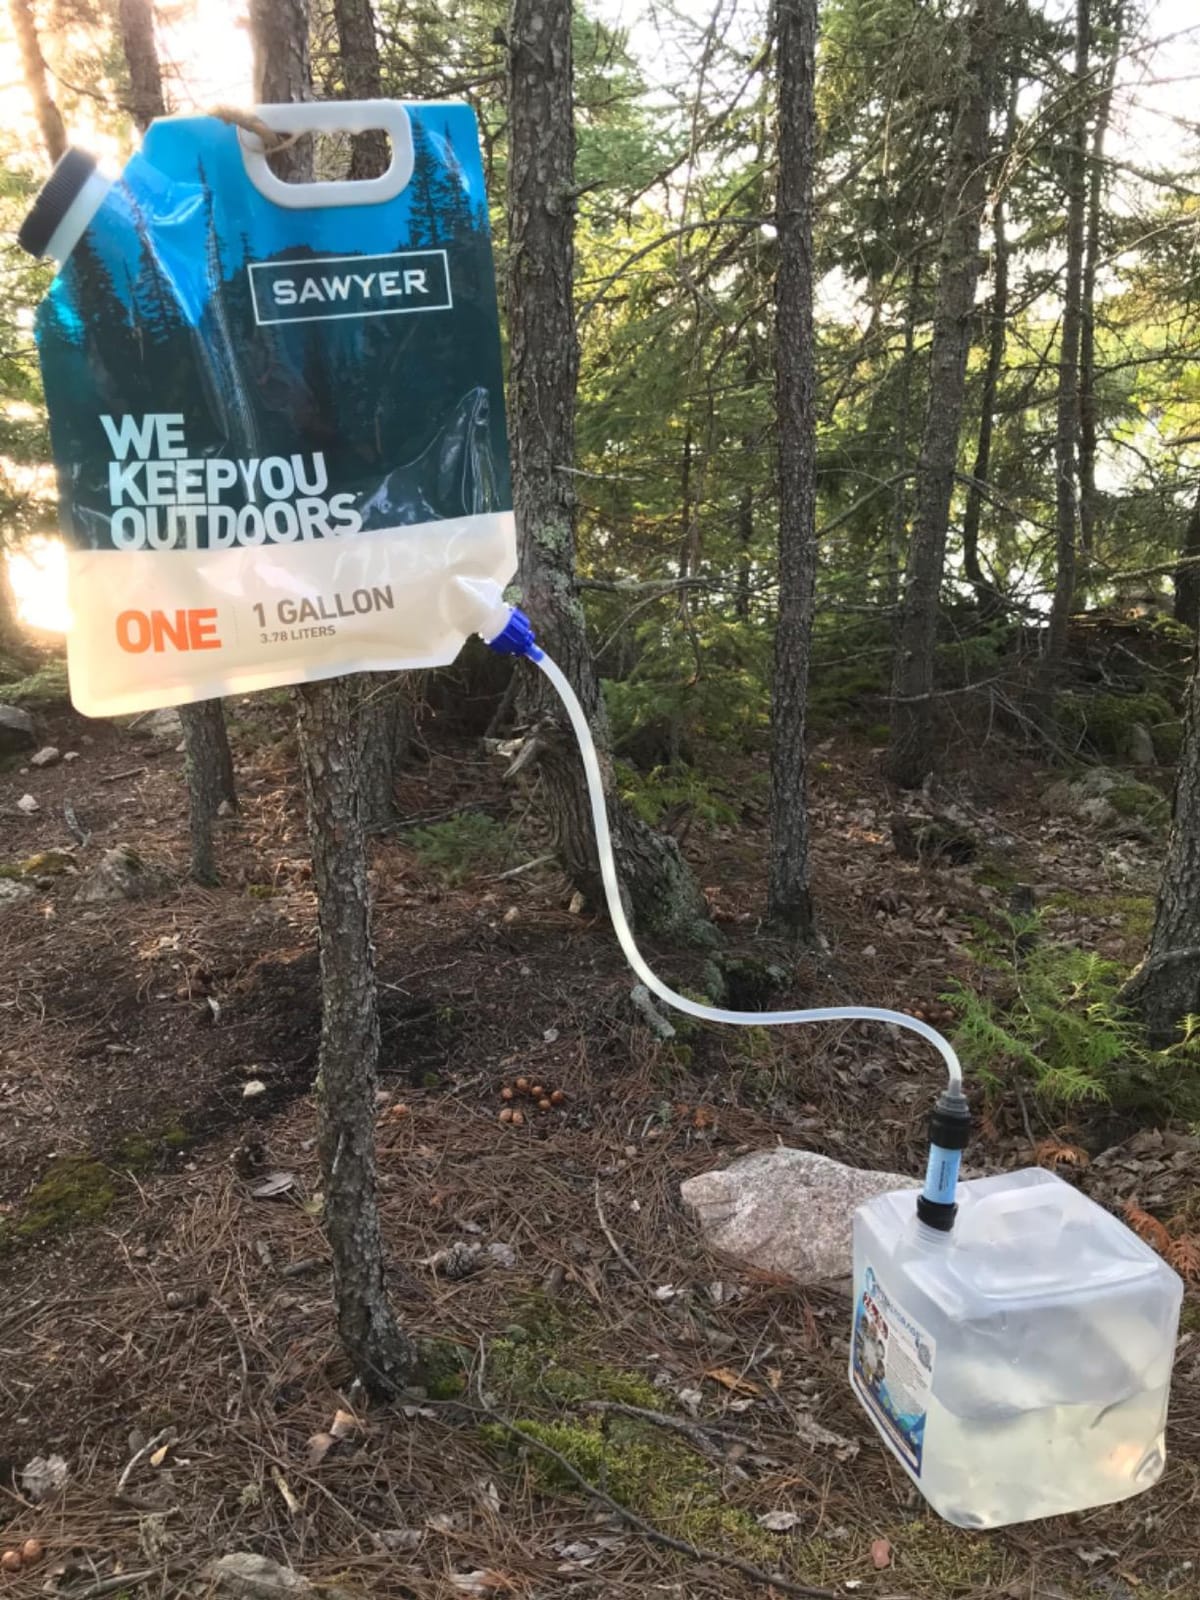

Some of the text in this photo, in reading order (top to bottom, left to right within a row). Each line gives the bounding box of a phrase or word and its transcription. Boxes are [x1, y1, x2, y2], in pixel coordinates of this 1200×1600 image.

[272, 268, 429, 305] SAWYER
[99, 413, 188, 459] WE
[110, 493, 363, 550] OUTDOORS
[252, 585, 394, 628] 1 GALLON
[115, 607, 222, 653] ONE
[260, 625, 336, 644] 3.78 LITERS
